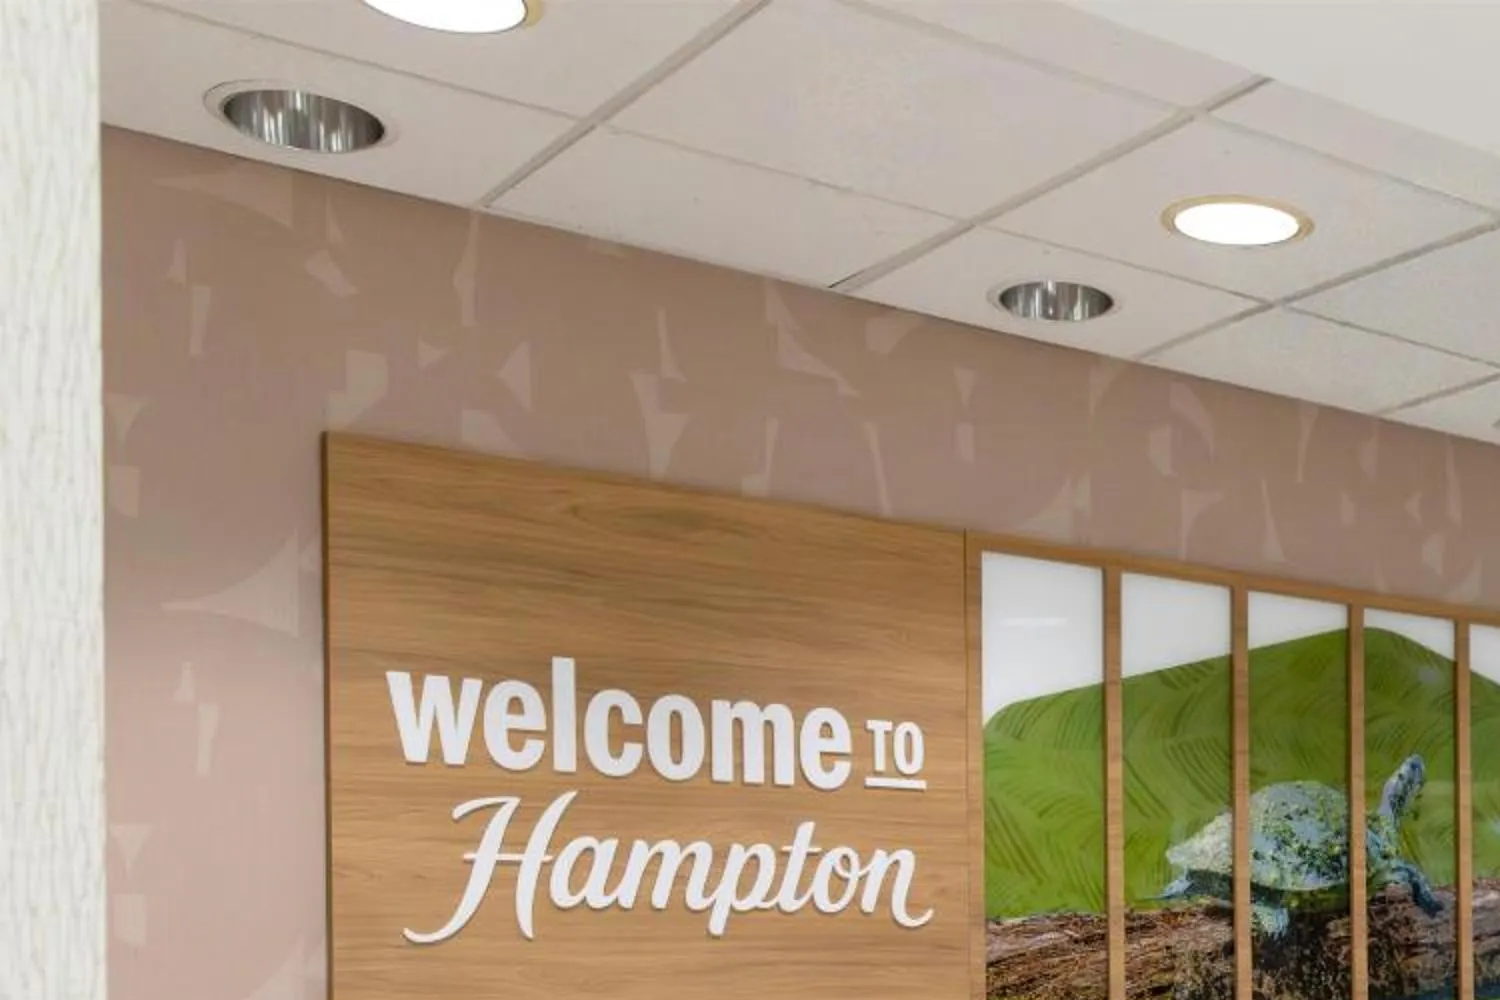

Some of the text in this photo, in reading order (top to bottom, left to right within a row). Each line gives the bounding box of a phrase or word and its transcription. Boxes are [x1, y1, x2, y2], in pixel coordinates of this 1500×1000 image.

[386, 656, 926, 789] welcome TO
[402, 790, 934, 943] Hampton
